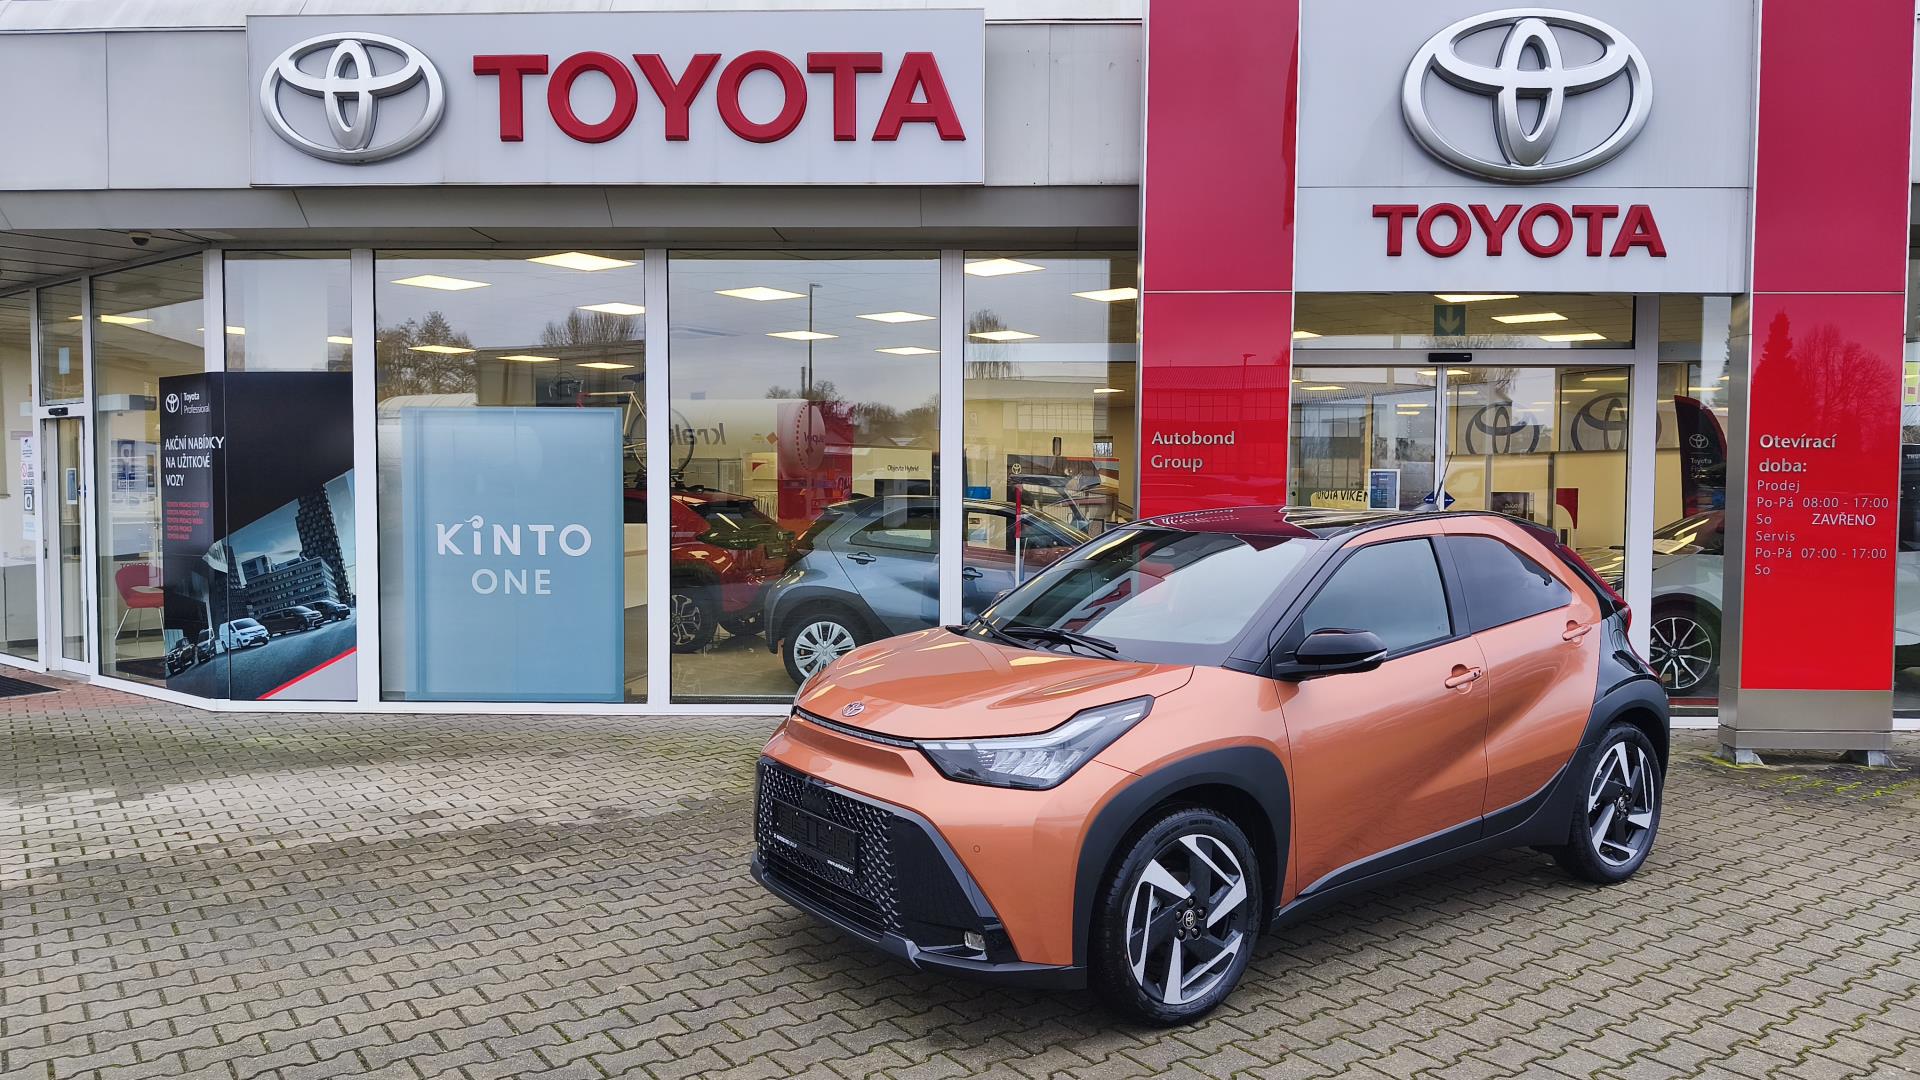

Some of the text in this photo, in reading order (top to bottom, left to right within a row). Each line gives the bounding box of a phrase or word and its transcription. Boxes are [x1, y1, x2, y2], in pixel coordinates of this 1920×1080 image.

[473, 50, 966, 143] TOYOTA
[1372, 203, 1666, 258] TOYOTA
[184, 392, 200, 403] Toyota
[184, 403, 210, 414] Professional
[165, 433, 224, 450] AKČNÍ NABÍDKY
[1151, 431, 1235, 445] Autobond
[1759, 434, 1838, 448] Otevírací
[166, 452, 210, 468] NA UŽITKOVÉ
[1150, 455, 1203, 473] Group
[1759, 458, 1807, 473] doba:
[166, 474, 185, 487] VOZY
[1757, 480, 1800, 493] Prodej
[1756, 497, 1794, 508] Po-Pá
[1802, 498, 1839, 508] 08:00
[1854, 498, 1889, 508] 17:00
[1756, 513, 1876, 526] So ZAVŘENO
[1755, 531, 1795, 542] Servis
[1755, 548, 1792, 559] Po-Pá
[1801, 548, 1837, 559] 07:00
[1852, 549, 1887, 559] 17:00
[1754, 565, 1771, 575] So
[471, 569, 551, 595] ONE
